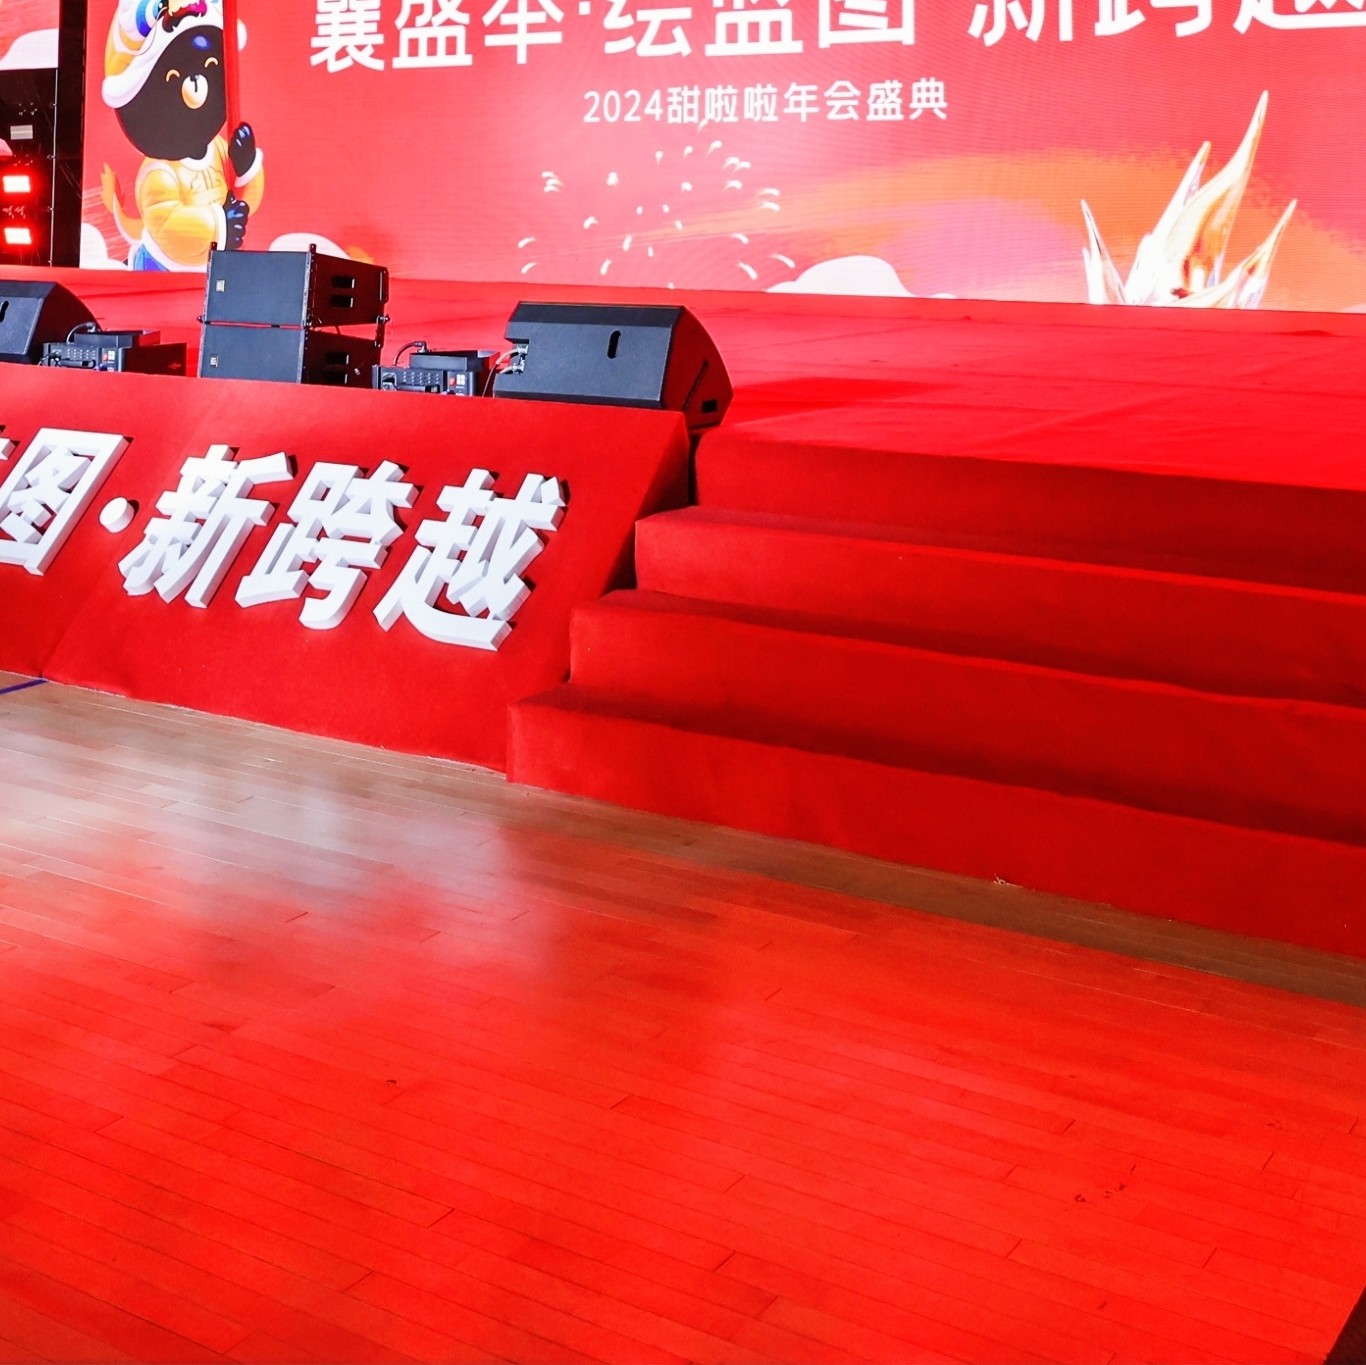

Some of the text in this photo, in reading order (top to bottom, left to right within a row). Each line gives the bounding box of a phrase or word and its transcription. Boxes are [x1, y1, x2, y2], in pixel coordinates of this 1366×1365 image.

[583, 77, 948, 126] 2024甜啦啦年会盛典
